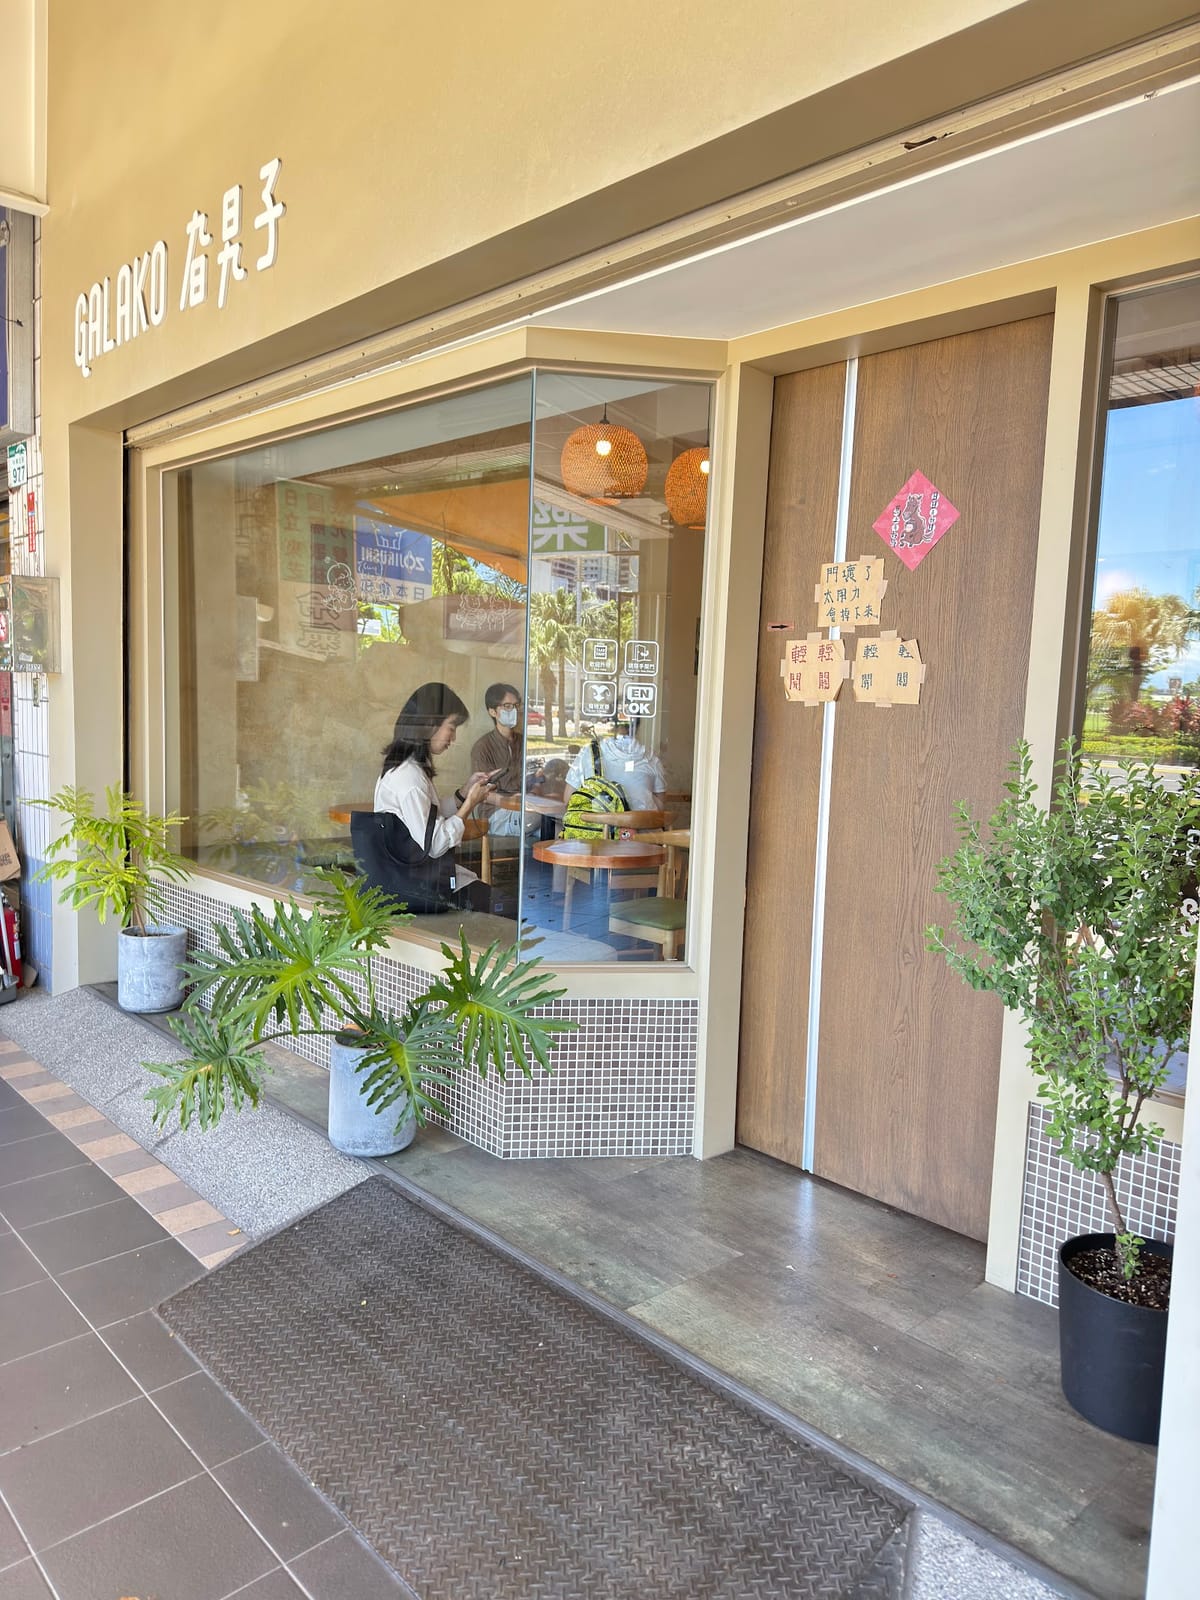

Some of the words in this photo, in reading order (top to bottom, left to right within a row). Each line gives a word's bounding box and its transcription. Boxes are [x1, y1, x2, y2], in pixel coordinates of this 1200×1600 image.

[74, 240, 168, 378] GALAKO
[180, 157, 286, 311] 旮旯子
[12, 465, 25, 484] 977
[826, 564, 871, 584] 門壞了
[823, 587, 860, 604] 太用力
[631, 688, 649, 698] EN
[628, 702, 650, 714] OK
